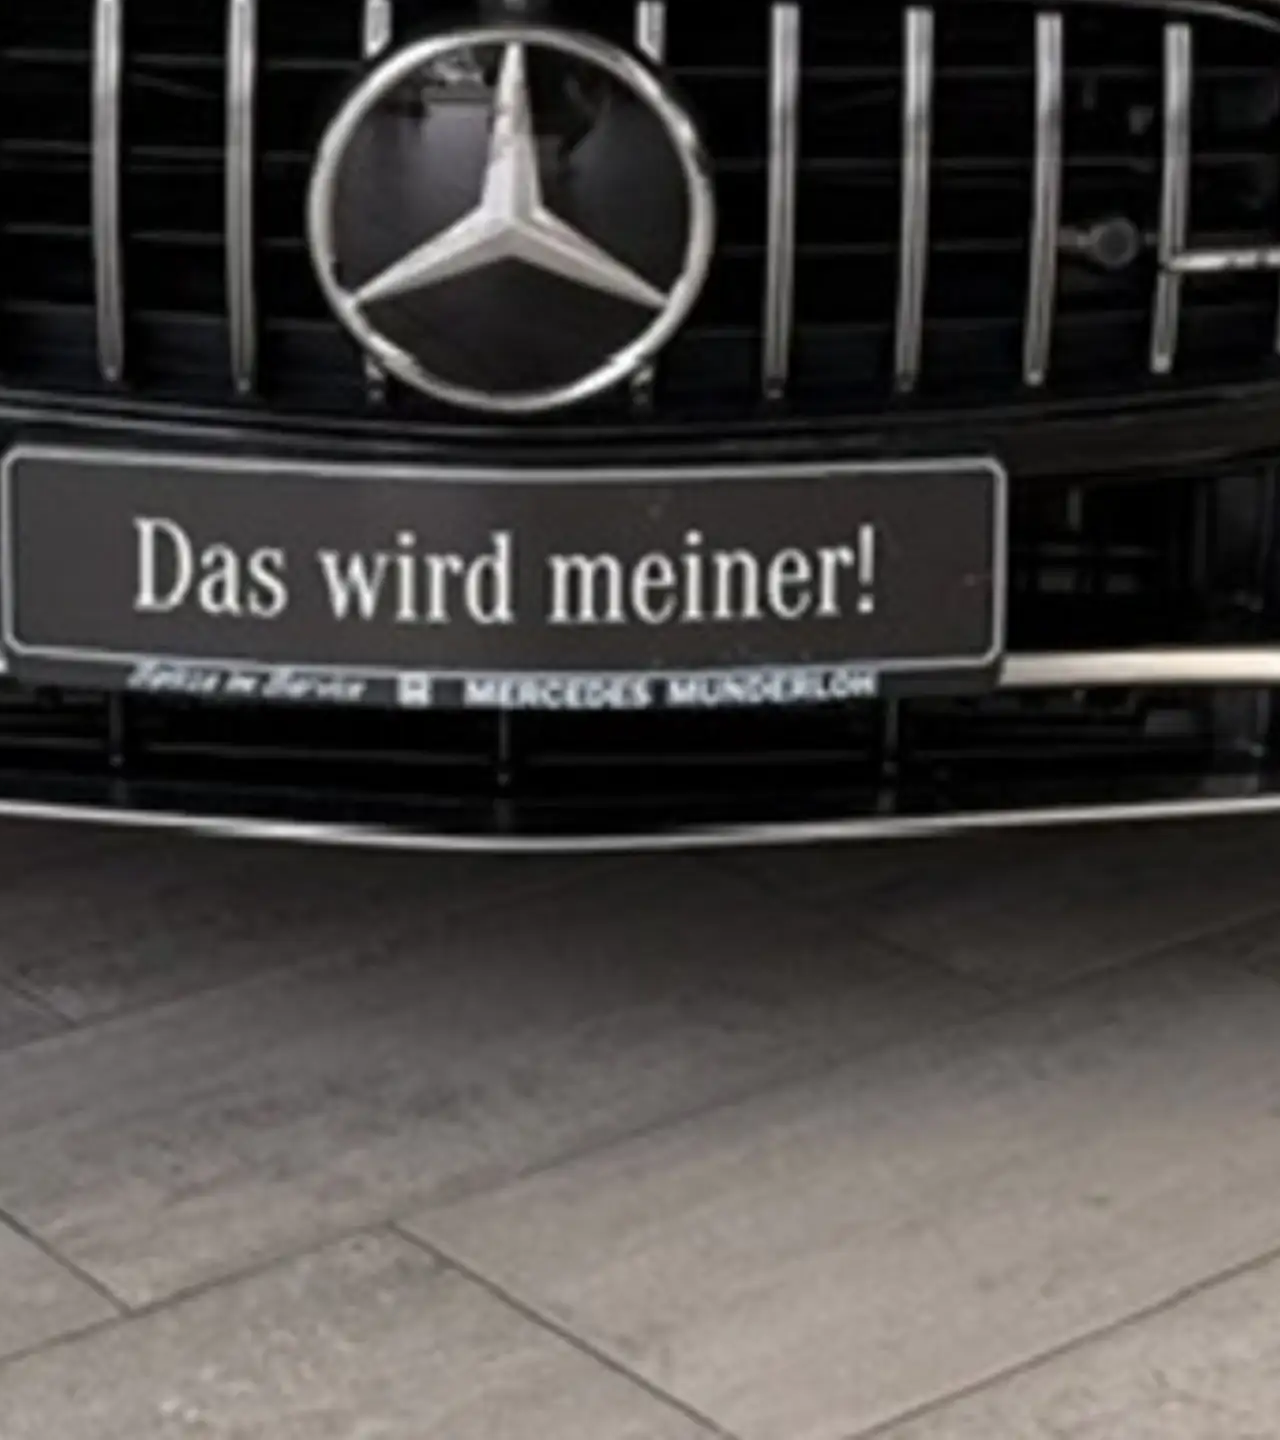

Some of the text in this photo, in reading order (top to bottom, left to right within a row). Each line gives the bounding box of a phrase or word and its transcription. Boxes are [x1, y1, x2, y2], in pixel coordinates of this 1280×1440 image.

[132, 516, 876, 625] Das wird meiner!
[464, 675, 651, 709] MERCEDES
